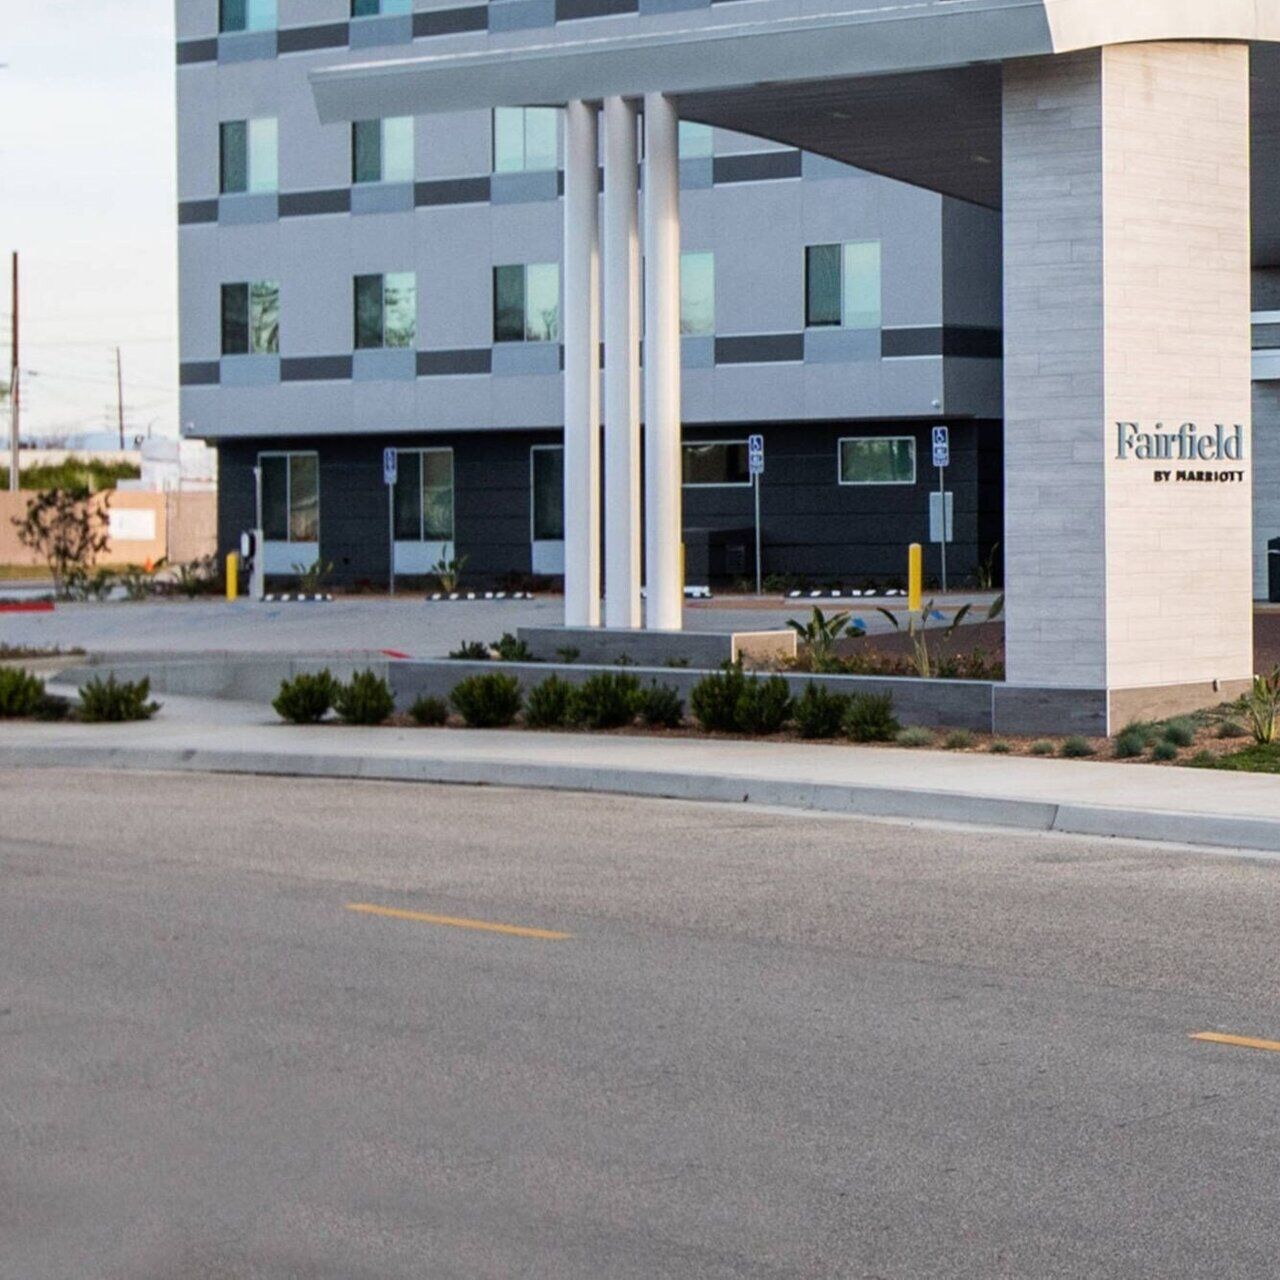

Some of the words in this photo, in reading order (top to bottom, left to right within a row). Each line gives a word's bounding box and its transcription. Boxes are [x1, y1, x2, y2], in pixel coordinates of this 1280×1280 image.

[1115, 421, 1244, 461] Fairfield
[1153, 470, 1172, 483] BY
[1175, 469, 1245, 483] MARRIOTT
